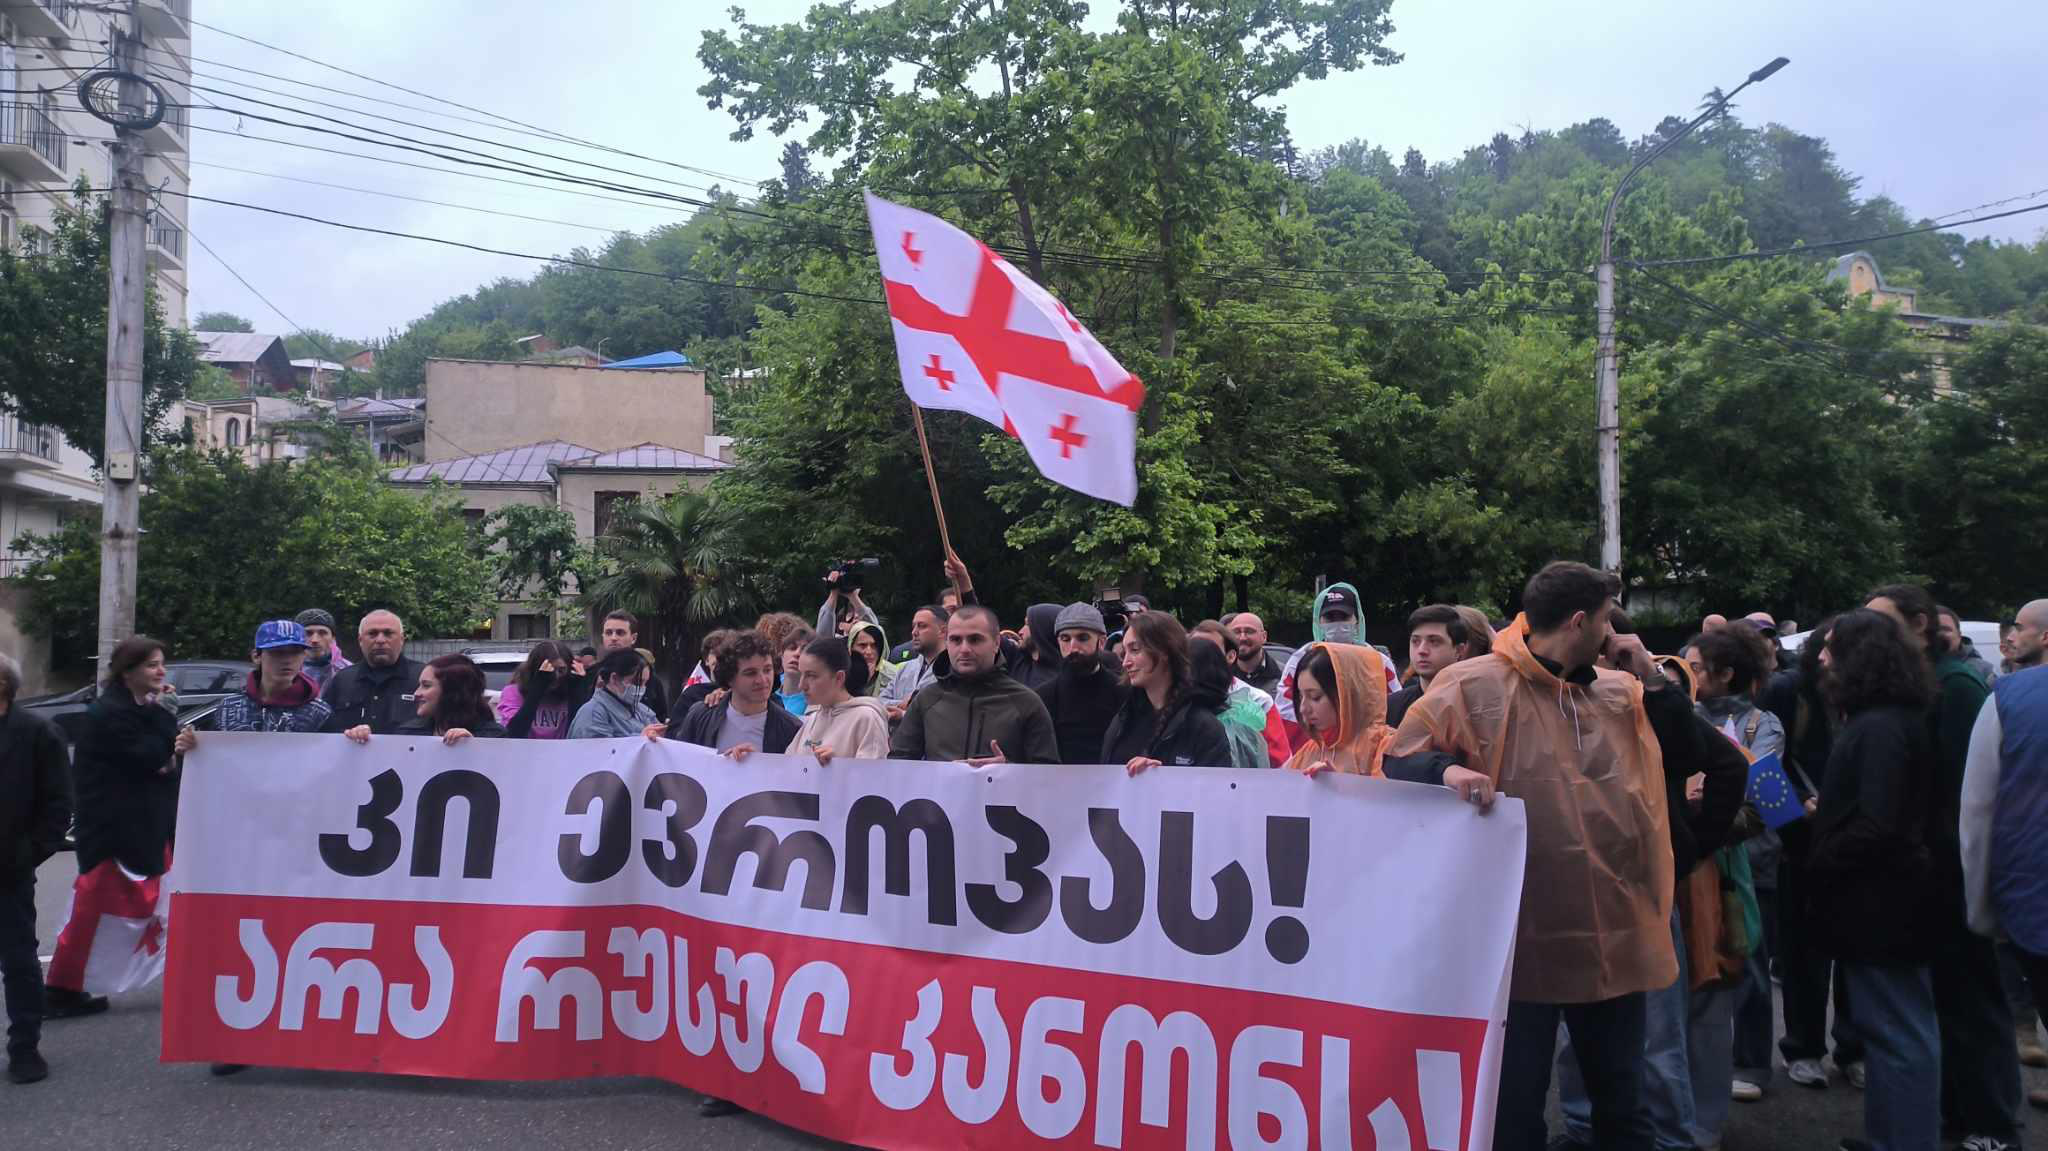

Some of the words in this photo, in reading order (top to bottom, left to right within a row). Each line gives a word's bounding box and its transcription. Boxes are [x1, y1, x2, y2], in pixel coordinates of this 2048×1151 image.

[317, 768, 501, 880] კი
[557, 770, 1311, 965] ევროპას!
[214, 918, 455, 1040] არა
[495, 926, 850, 1095] რუსულ
